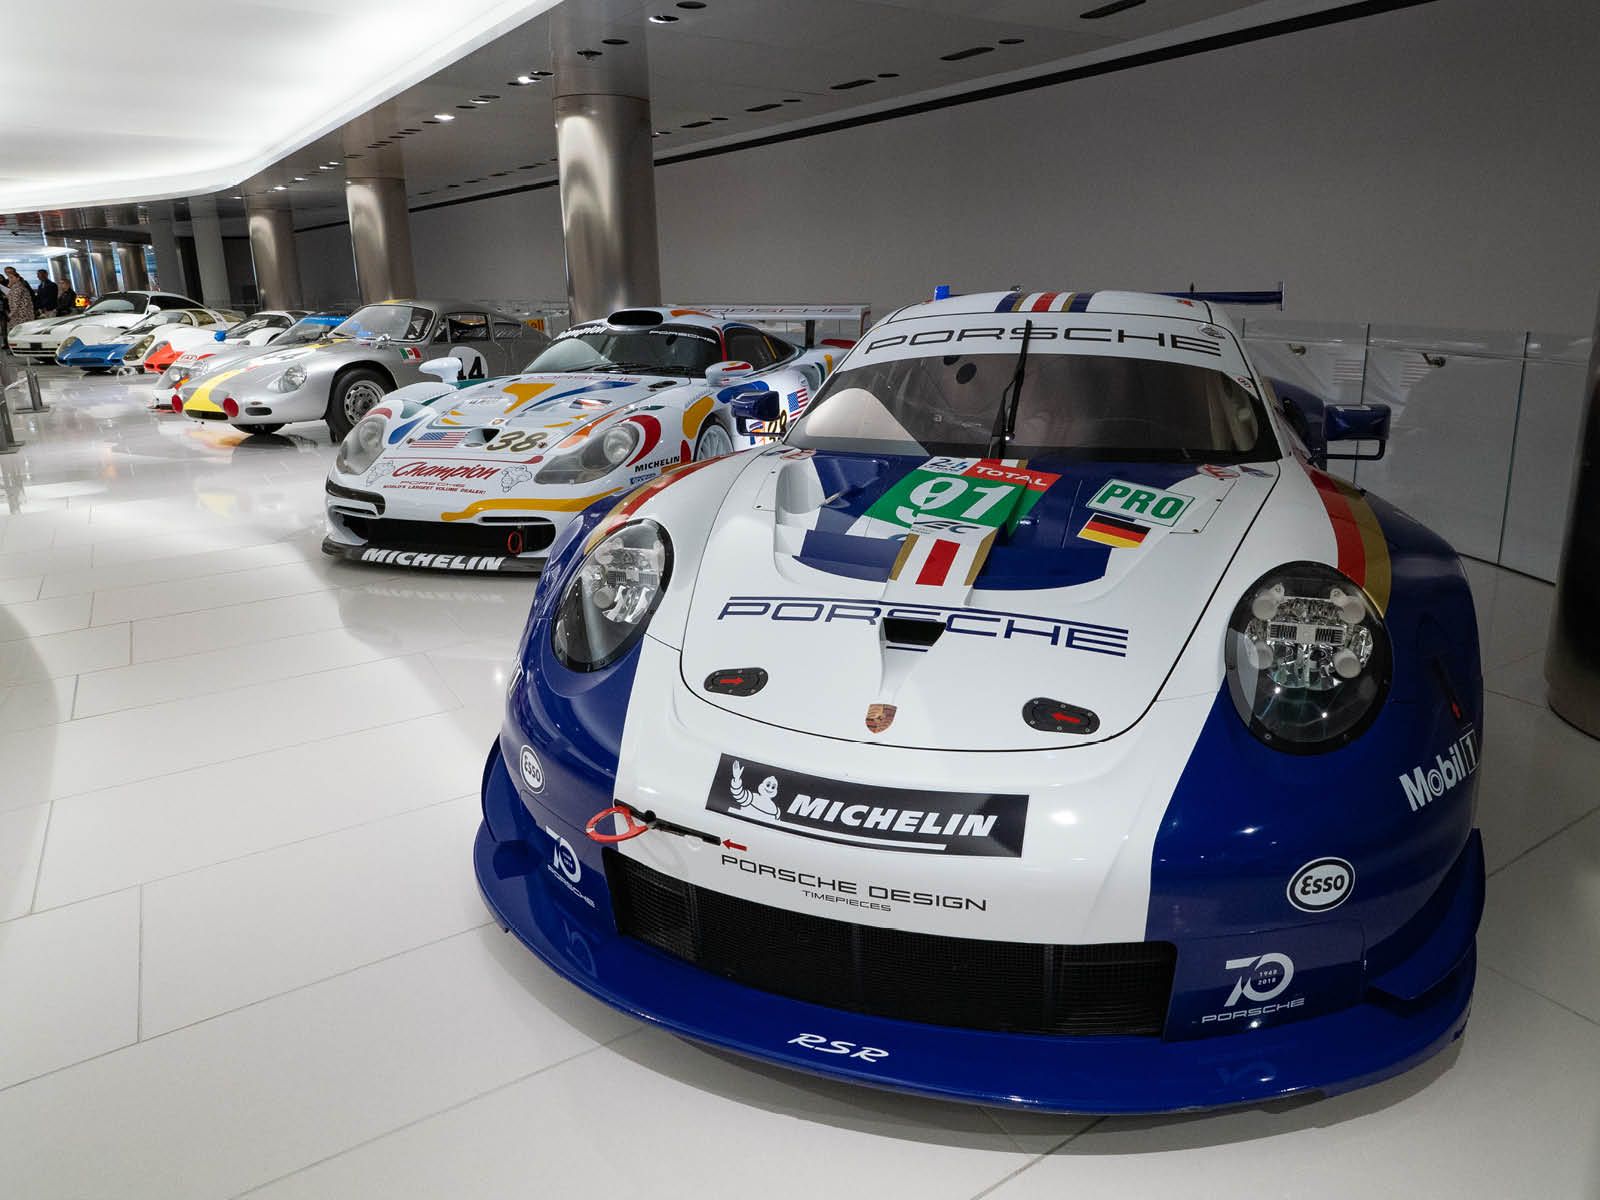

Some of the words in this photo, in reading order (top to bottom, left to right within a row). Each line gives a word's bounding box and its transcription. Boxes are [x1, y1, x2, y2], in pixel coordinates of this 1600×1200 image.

[649, 330, 717, 344] PORSCHE
[864, 326, 1222, 357] PORSCHE
[486, 430, 548, 452] 38
[392, 461, 501, 481] Champion
[634, 455, 680, 473] MICHELIN
[975, 466, 1049, 486] TOTAL
[895, 476, 1016, 525] 91
[1096, 484, 1184, 519] PRO
[361, 547, 506, 571] MICHELIN
[717, 601, 1129, 657] PORSCHE
[1399, 743, 1467, 812] Mobil
[787, 793, 999, 839] MICHELIN
[721, 854, 858, 893] PORSCHE
[868, 885, 987, 912] DESIGN
[802, 889, 892, 912] TIMEPIECES
[1224, 952, 1295, 1007] 70
[1201, 997, 1305, 1024] PORSCHE
[787, 1033, 889, 1063] RSR
